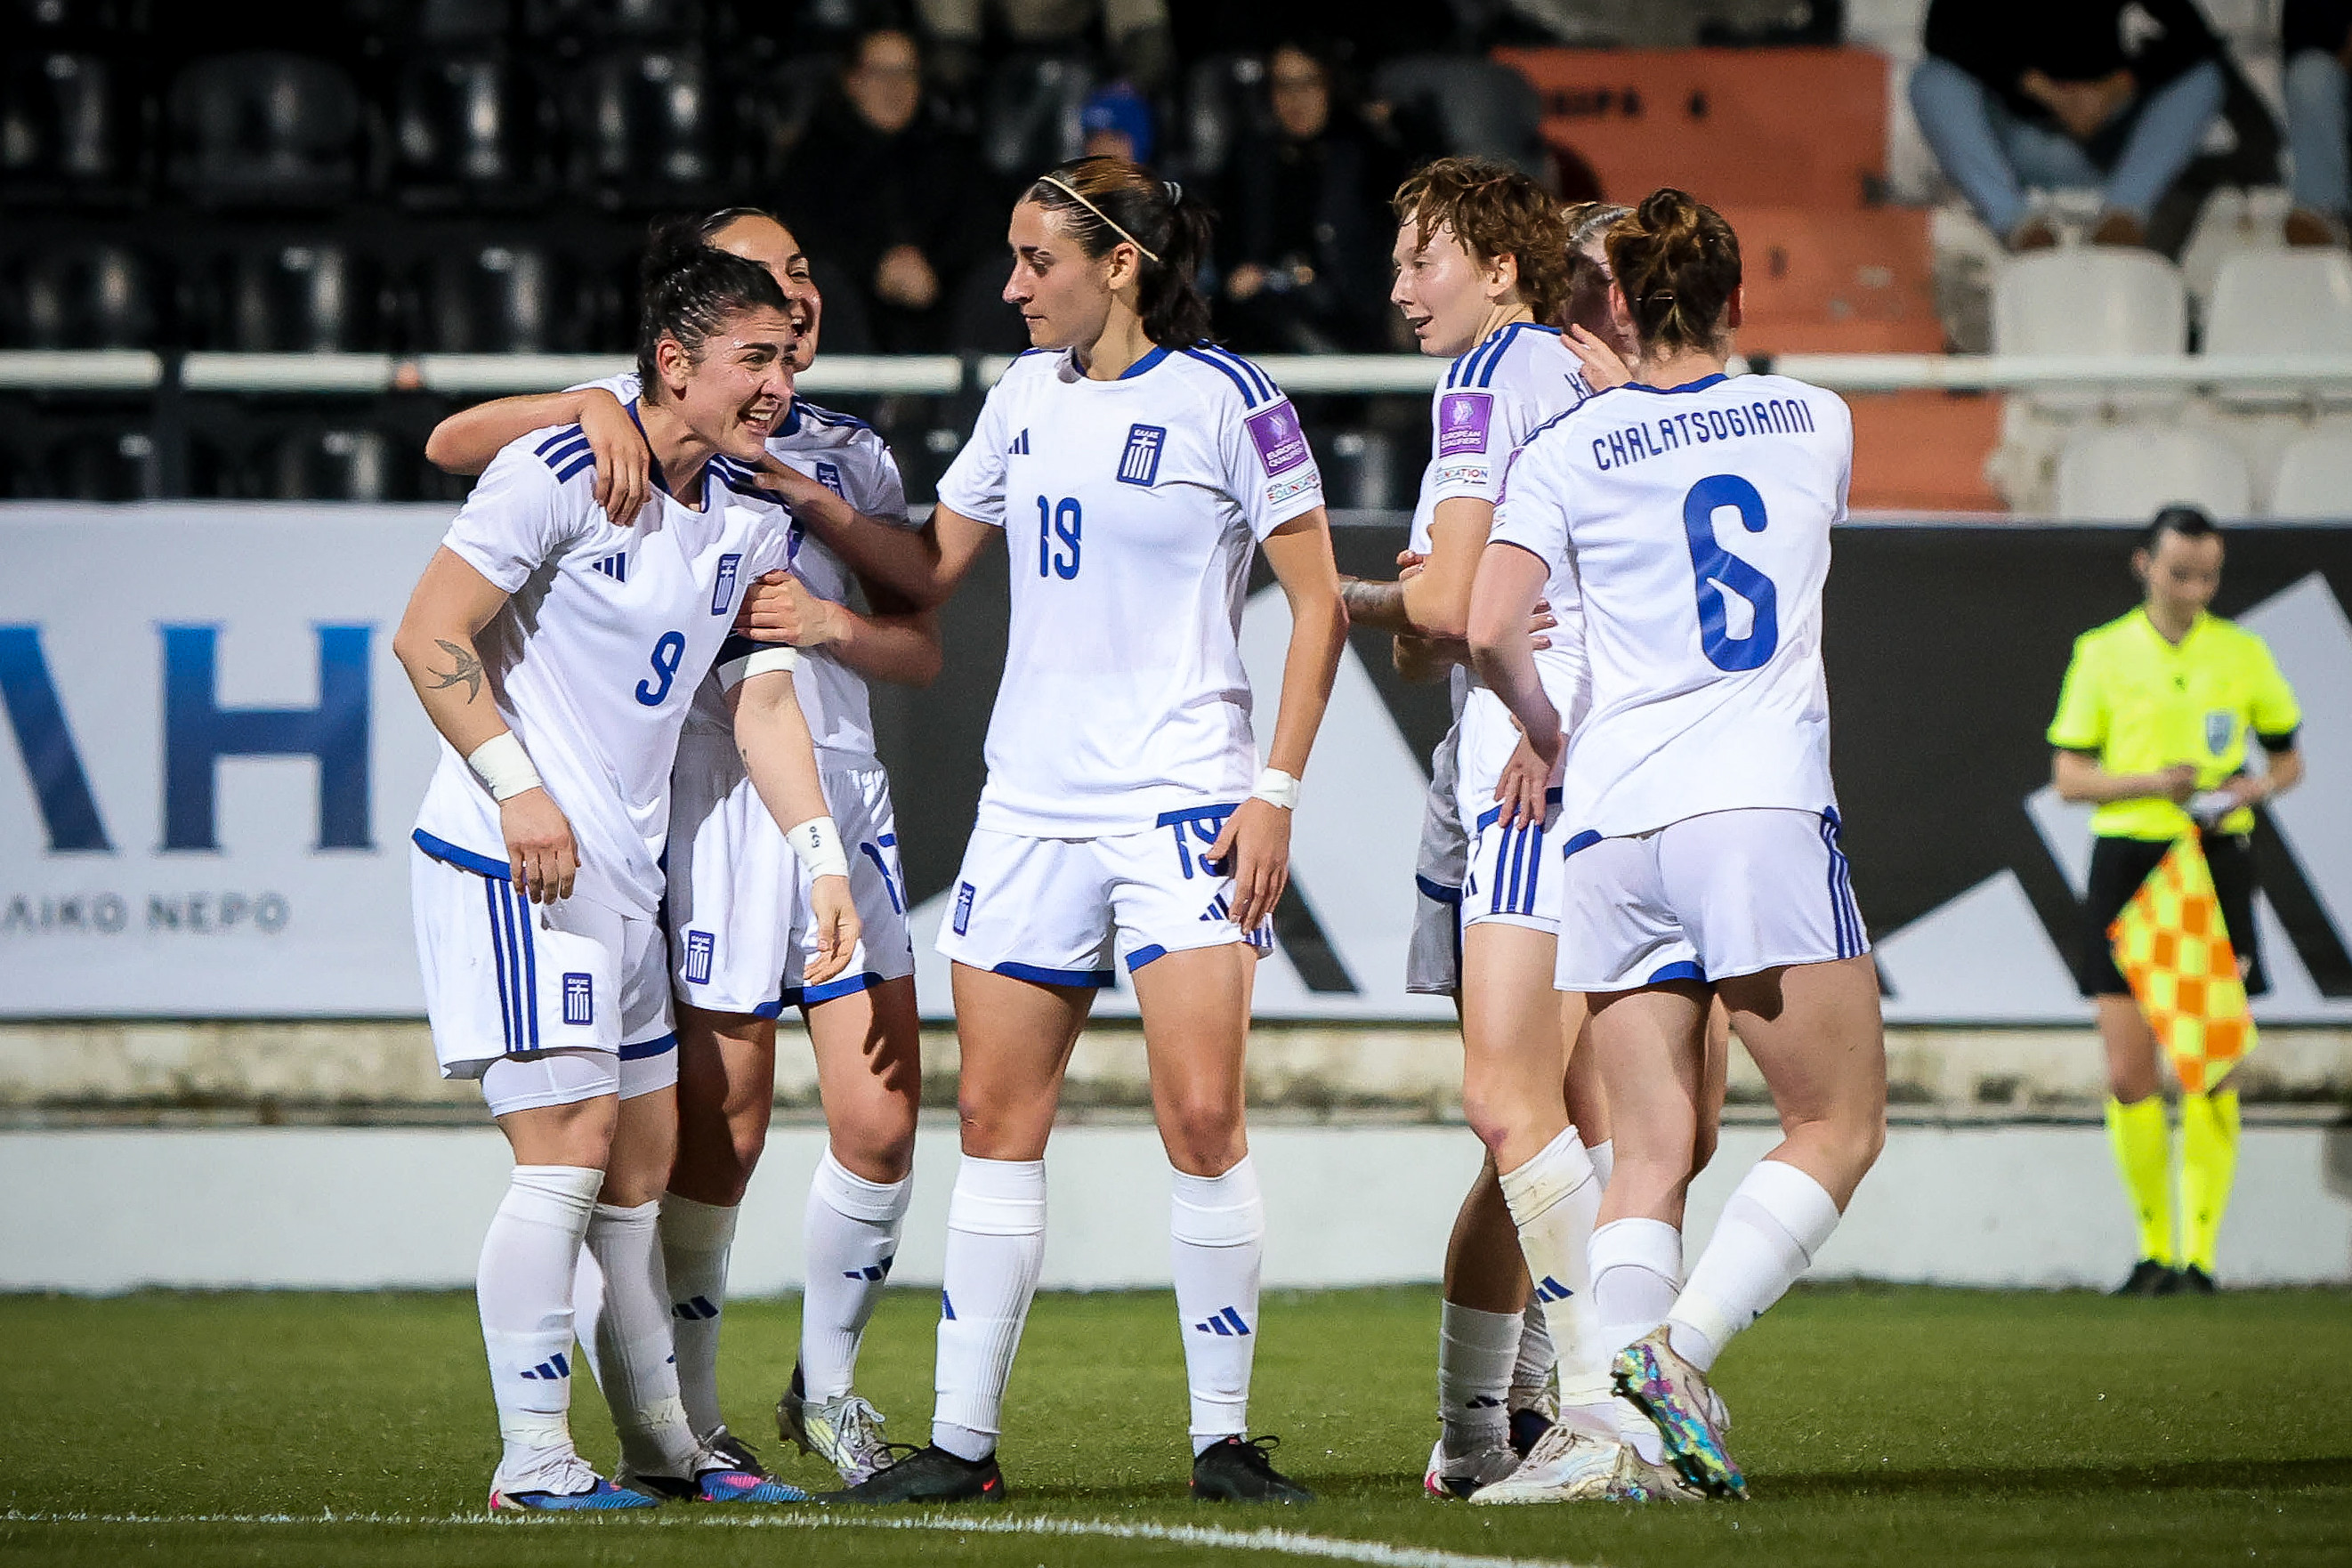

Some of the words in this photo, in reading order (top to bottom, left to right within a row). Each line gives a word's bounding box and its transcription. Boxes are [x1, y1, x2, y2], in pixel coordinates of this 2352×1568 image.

[1592, 399, 1816, 471] CHALATSOGIANNI
[1038, 494, 1082, 580] 19
[1683, 473, 1779, 673] 6
[635, 630, 686, 707] 9
[147, 892, 291, 934] ΝΕΡΟ
